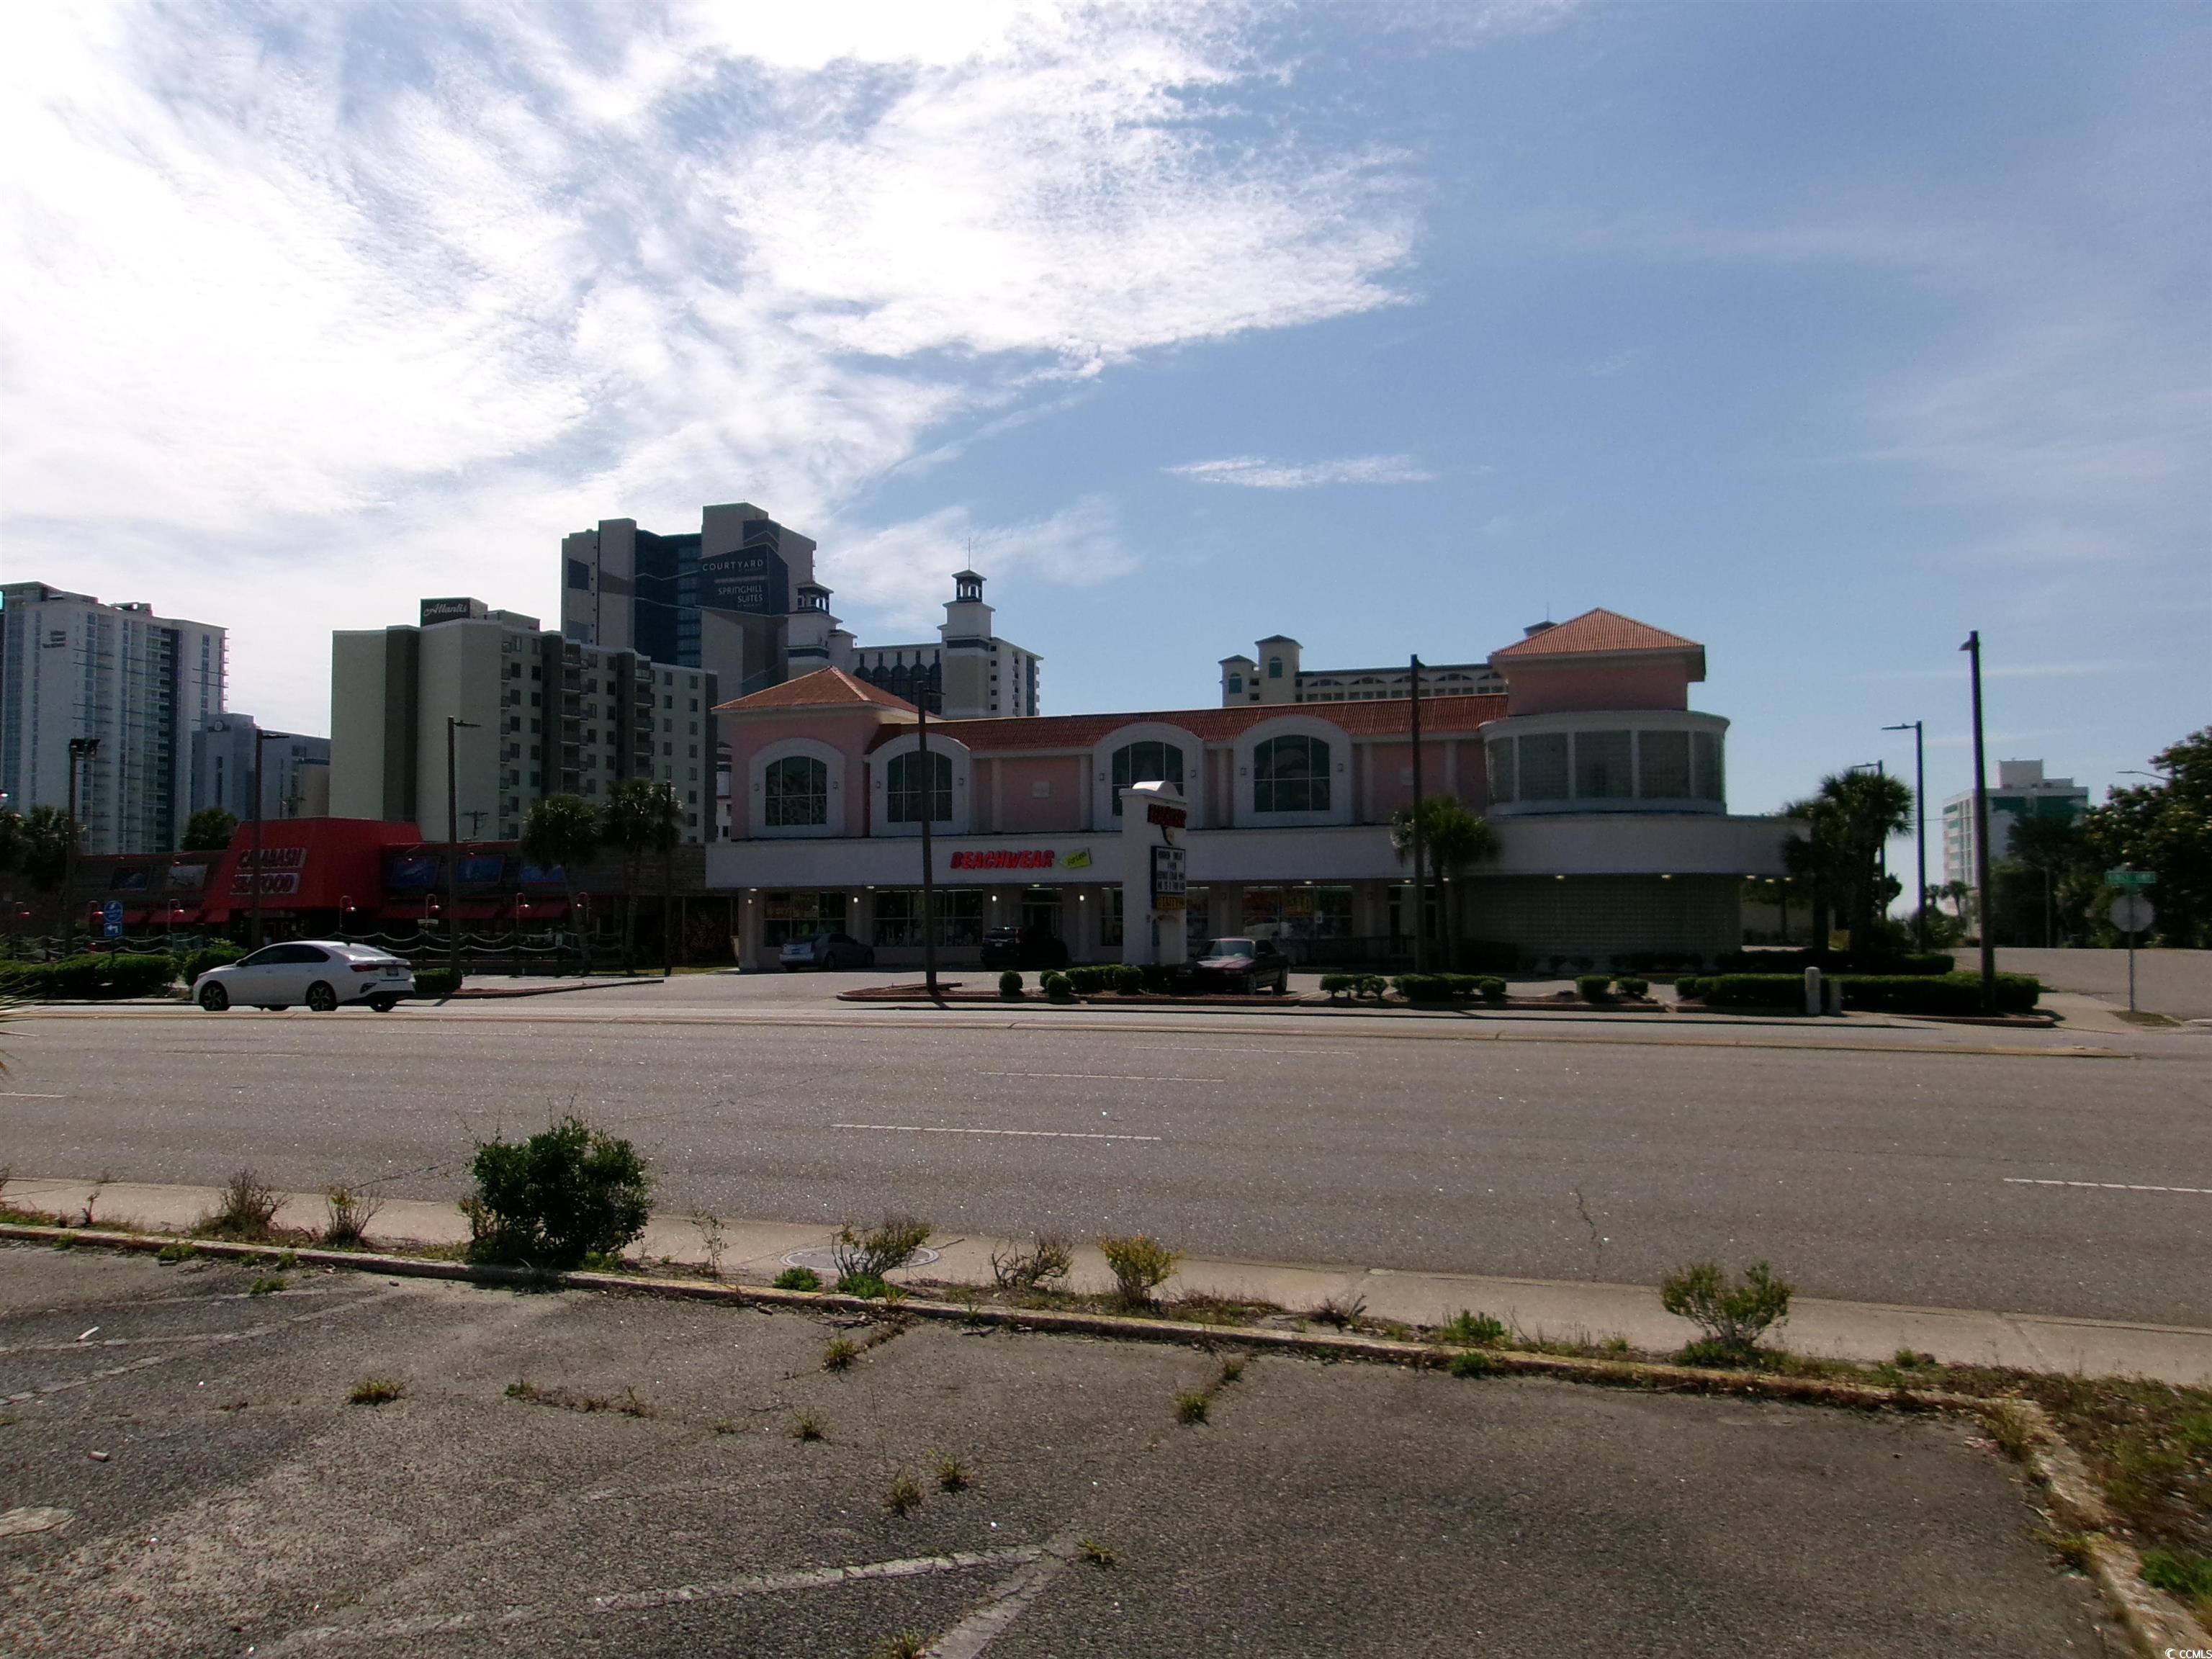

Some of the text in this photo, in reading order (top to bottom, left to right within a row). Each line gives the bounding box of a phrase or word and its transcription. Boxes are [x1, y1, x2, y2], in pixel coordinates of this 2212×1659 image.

[702, 559, 763, 571] COURTYARD
[719, 585, 763, 595] SPRINGHILL
[737, 594, 763, 603] SUITES
[237, 849, 302, 868] CAABASH
[950, 850, 1055, 869] BEACHWEAR
[231, 874, 296, 894] SEOOD
